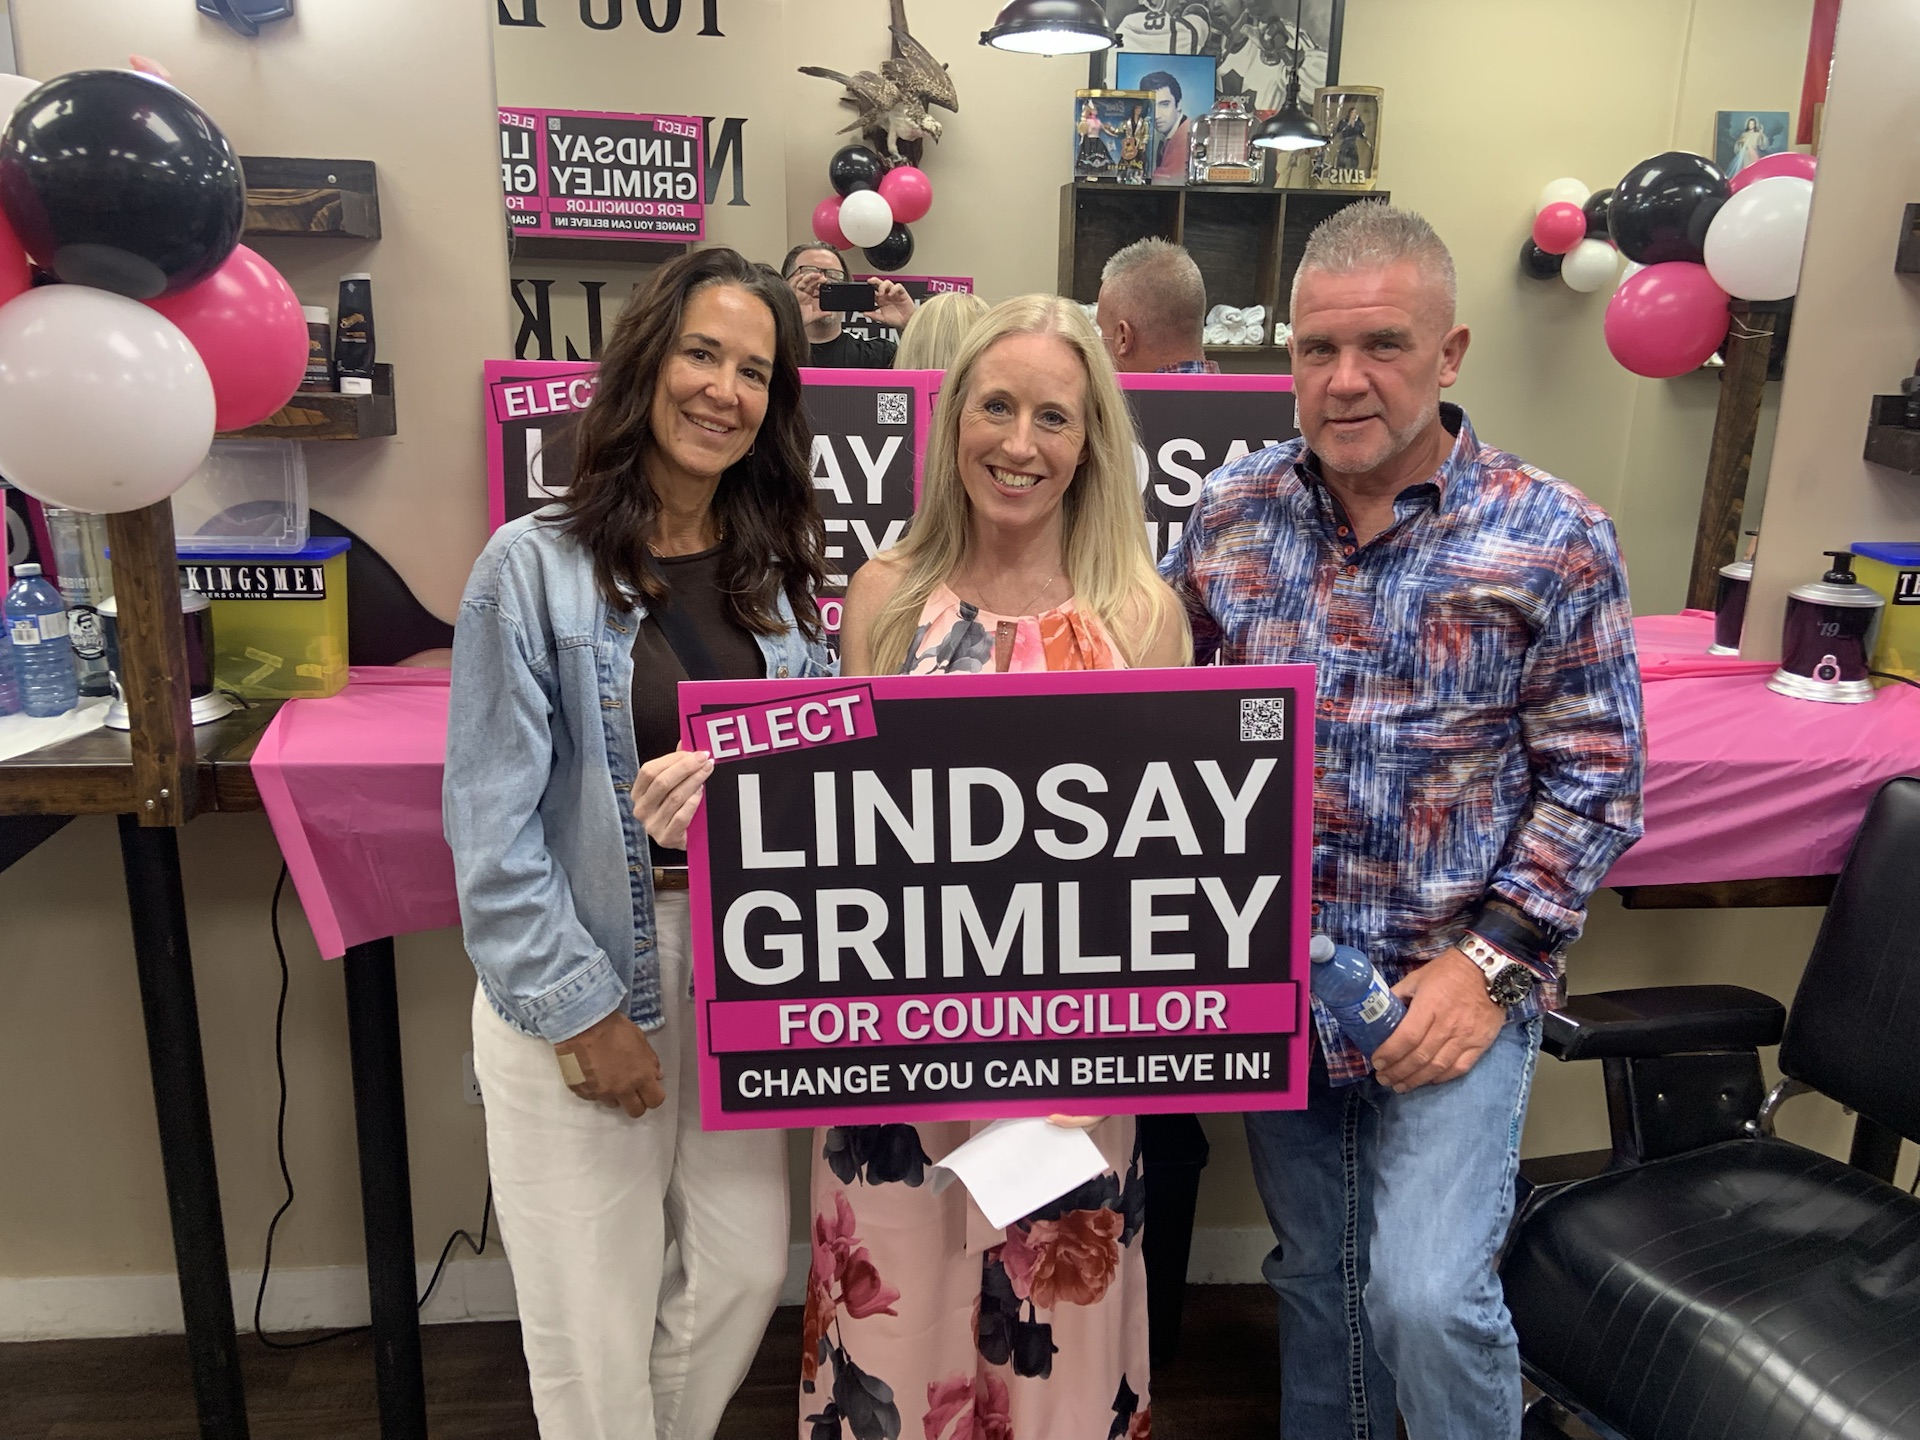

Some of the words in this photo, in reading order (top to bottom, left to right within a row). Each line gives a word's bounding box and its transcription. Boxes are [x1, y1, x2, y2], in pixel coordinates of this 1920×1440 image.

[185, 566, 323, 591] KINGSMEN
[705, 694, 861, 759] ELECT
[737, 758, 1278, 870] LINDSAY
[722, 875, 1281, 985] GRIMLEY
[778, 1002, 882, 1045] FOR
[897, 990, 1227, 1040] COUNCILLOR
[738, 1064, 890, 1099] CHANGE
[899, 1060, 974, 1092] YOU
[984, 1057, 1059, 1089] CAN
[1071, 1053, 1214, 1086] BELIEVE
[1225, 1051, 1271, 1081] IN!
